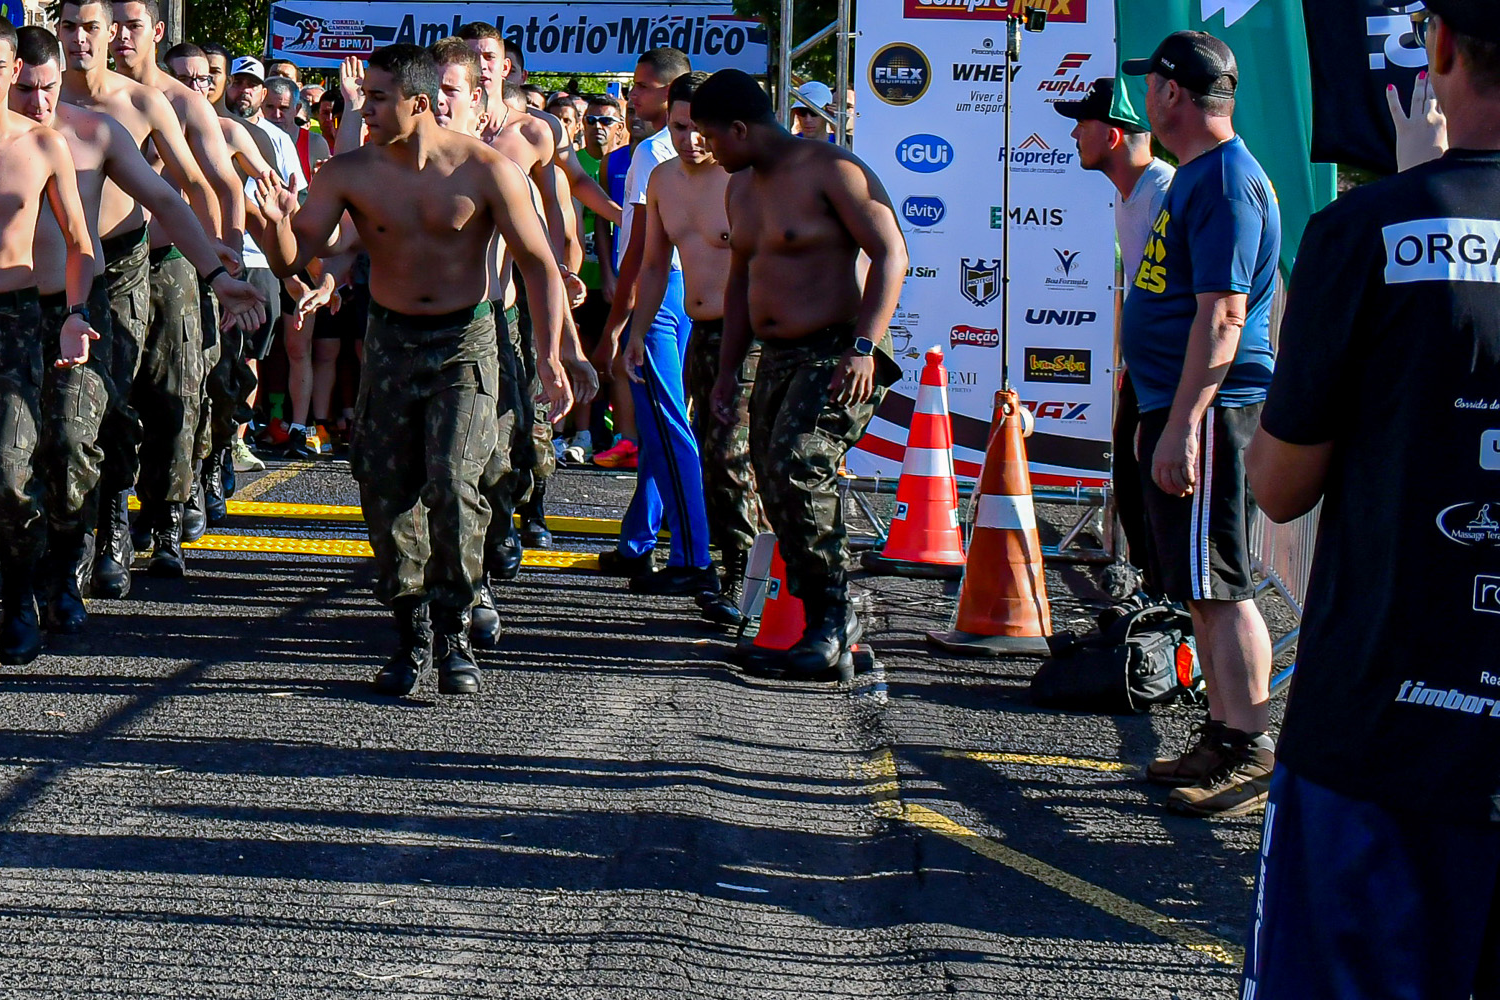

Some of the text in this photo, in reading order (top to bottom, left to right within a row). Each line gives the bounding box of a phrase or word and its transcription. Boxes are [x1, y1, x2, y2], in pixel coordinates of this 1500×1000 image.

[616, 13, 745, 56] Médico
[321, 39, 370, 50] 17º BPM/I
[875, 67, 922, 80] FLEX
[952, 64, 1022, 82] WHEY
[970, 91, 994, 101] Viver
[956, 104, 971, 112] um
[915, 267, 937, 278] Sin
[1025, 308, 1097, 326] UNIP
[951, 329, 999, 345] Seleção
[1454, 397, 1488, 409] Corrida
[1451, 529, 1485, 541] Massage
